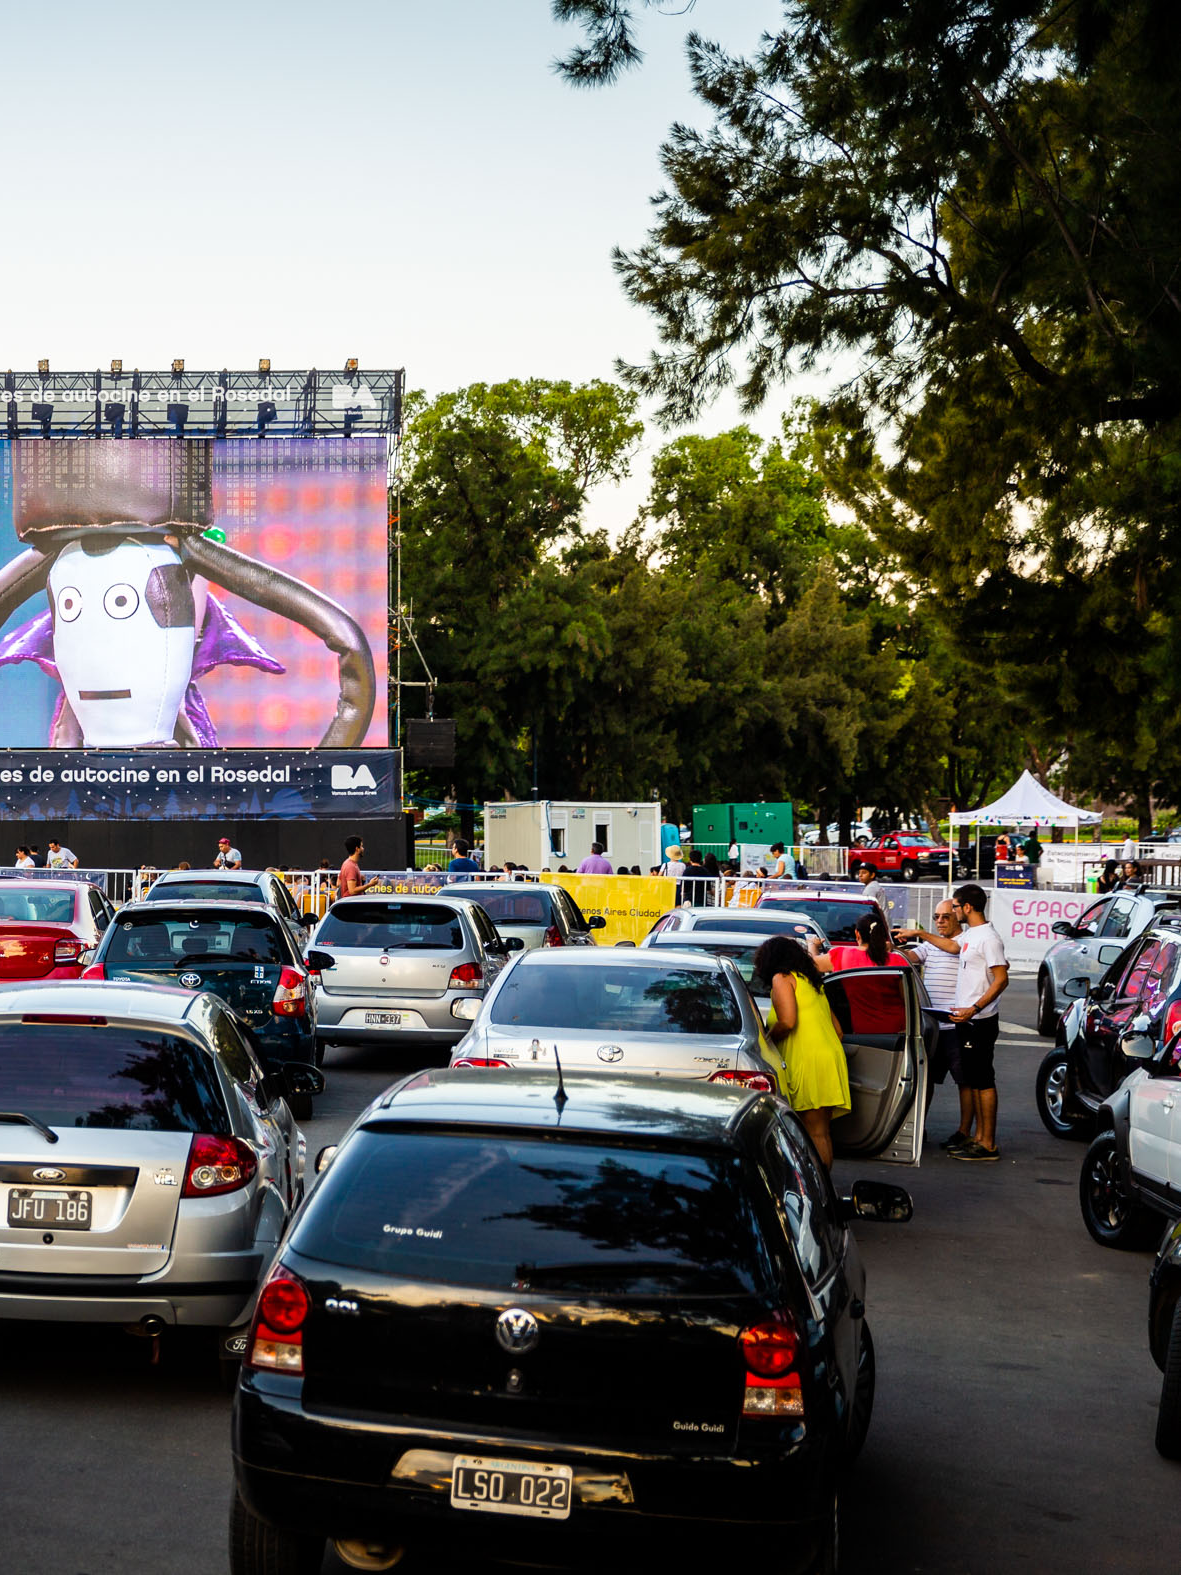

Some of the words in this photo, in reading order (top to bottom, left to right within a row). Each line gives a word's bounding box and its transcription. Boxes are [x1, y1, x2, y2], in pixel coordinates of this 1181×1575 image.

[30, 386, 55, 403] de
[61, 386, 150, 403] autocine
[157, 388, 181, 402] en
[187, 386, 204, 402] el
[212, 385, 291, 402] Rosedal
[332, 384, 377, 409] BA
[30, 766, 55, 783] de
[60, 766, 150, 783] autocine
[156, 768, 180, 783] en
[186, 765, 204, 783] el
[211, 765, 291, 783] Rosedal
[331, 764, 377, 790] BA
[395, 883, 409, 893] de
[604, 907, 628, 917] Aires
[629, 908, 661, 918] Ciudad
[1012, 899, 1089, 919] ESPACI
[384, 1013, 401, 1025] 337
[12, 1199, 45, 1220] JFU
[55, 1200, 89, 1221] 186
[382, 1223, 413, 1236] Grupo
[415, 1226, 443, 1239] Guidi
[673, 1421, 700, 1432] Guido
[701, 1423, 725, 1433] Guidi
[457, 1469, 504, 1501] LSO
[520, 1475, 567, 1508] 022
